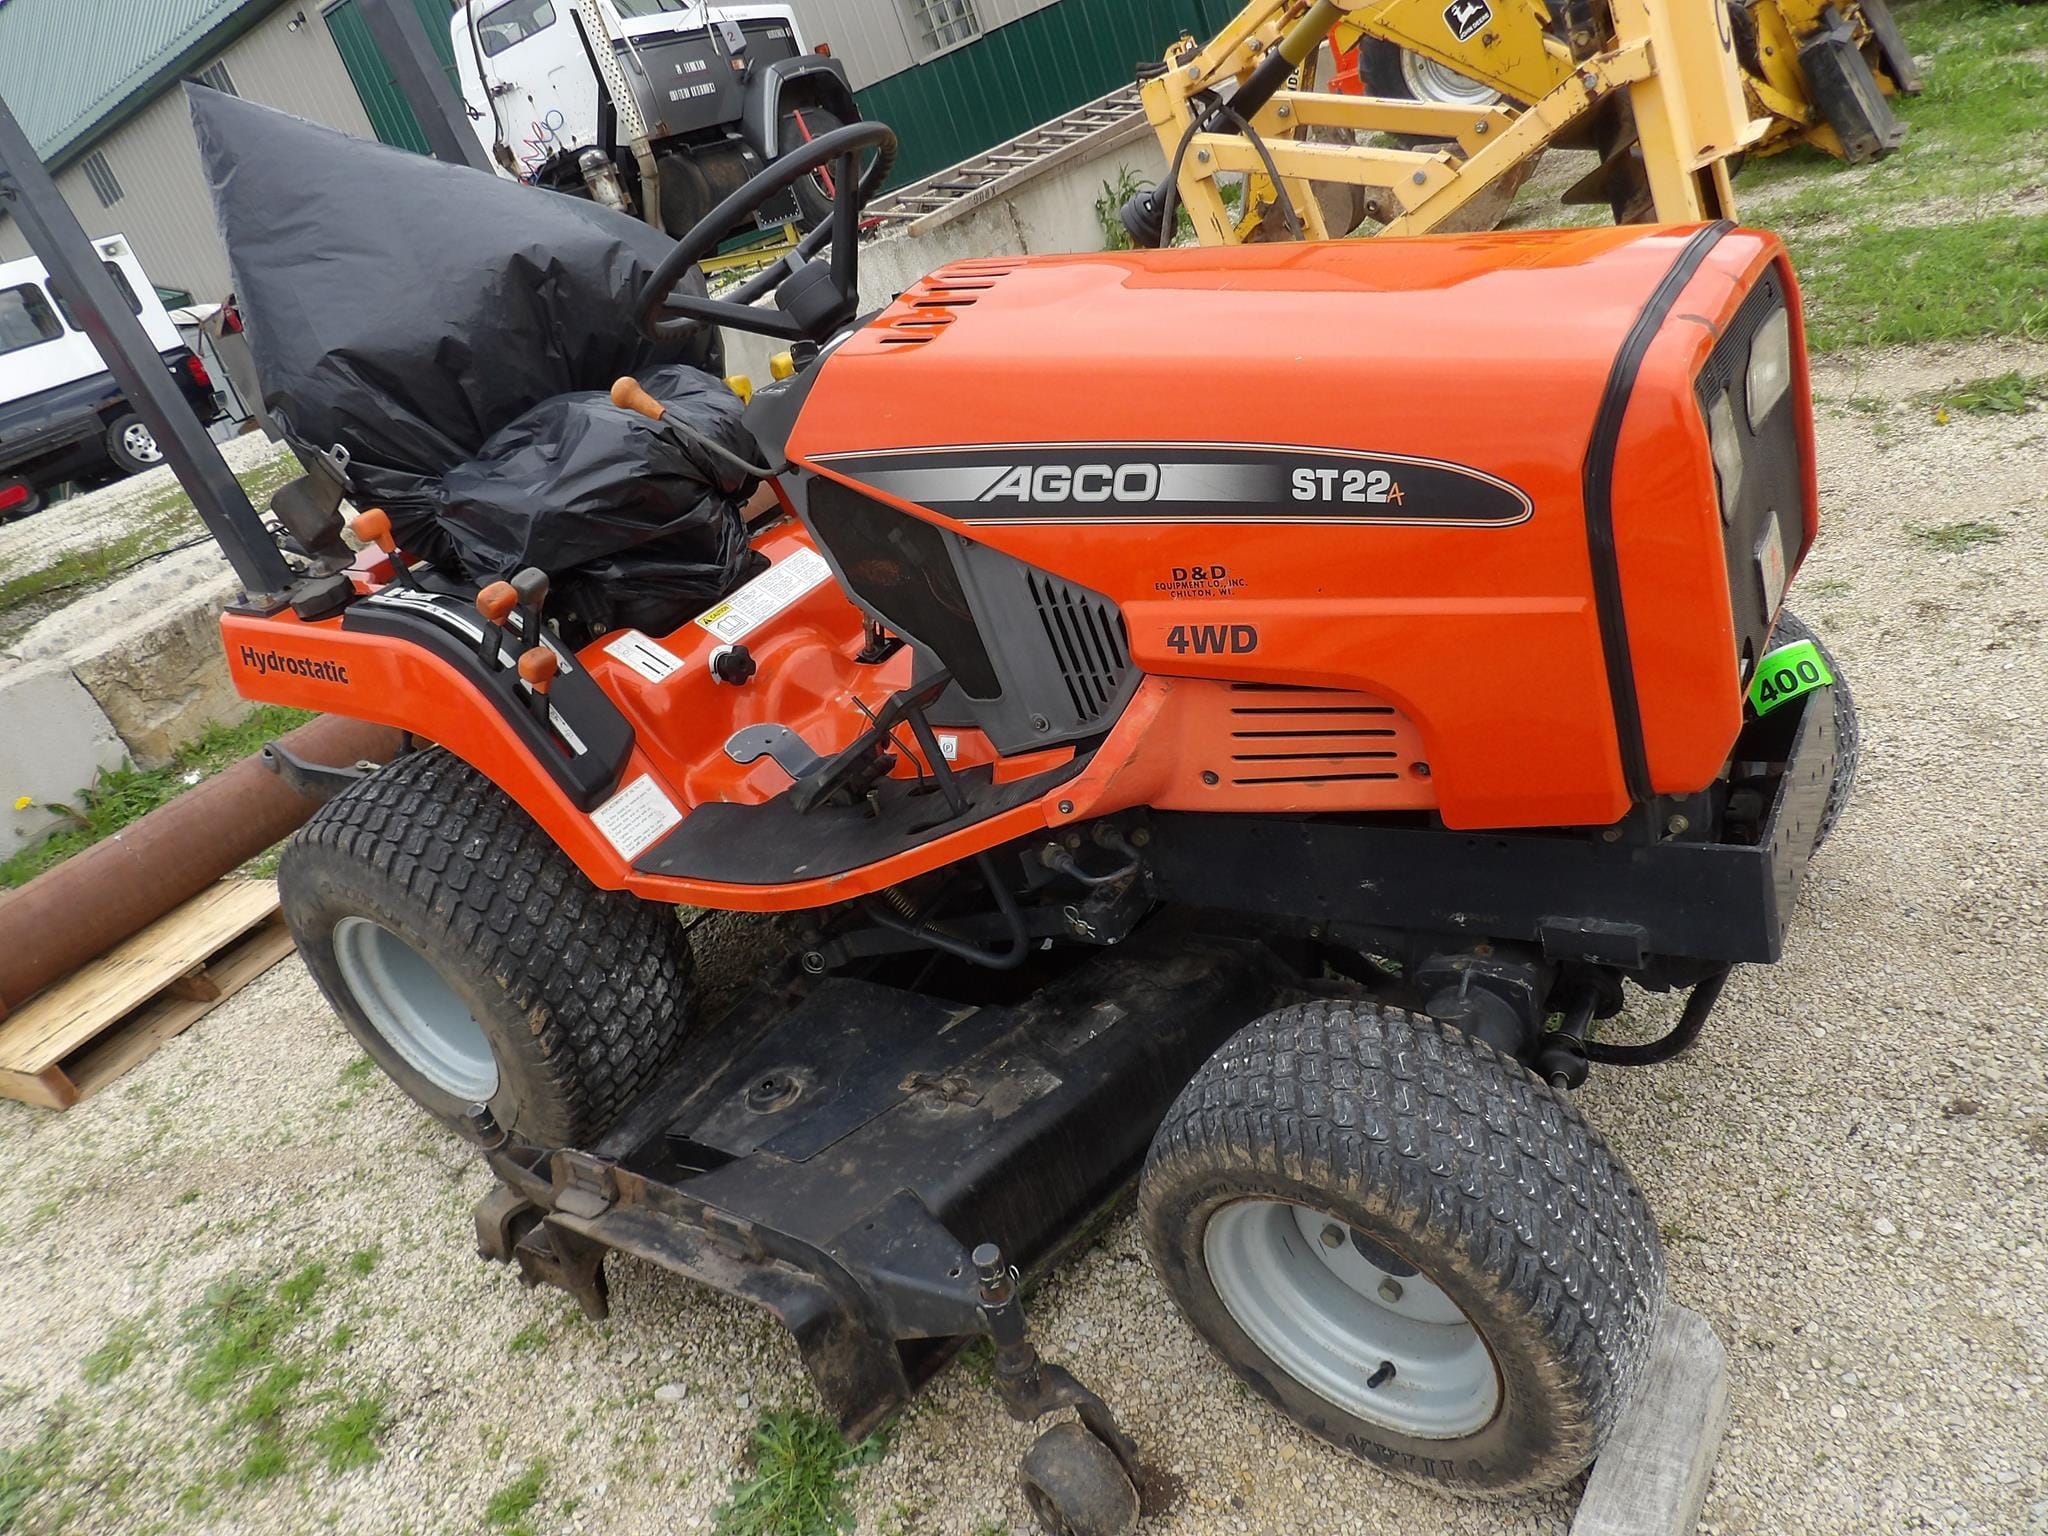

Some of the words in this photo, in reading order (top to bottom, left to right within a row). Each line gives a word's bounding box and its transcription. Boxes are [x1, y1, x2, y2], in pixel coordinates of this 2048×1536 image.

[979, 463, 1158, 502] AGCO
[1155, 581, 1205, 591] EQUIPMENT
[1229, 578, 1248, 587] INC.
[1167, 625, 1258, 655] 4WD
[240, 645, 349, 684] Hydrostatic
[1760, 660, 1820, 703] 400
